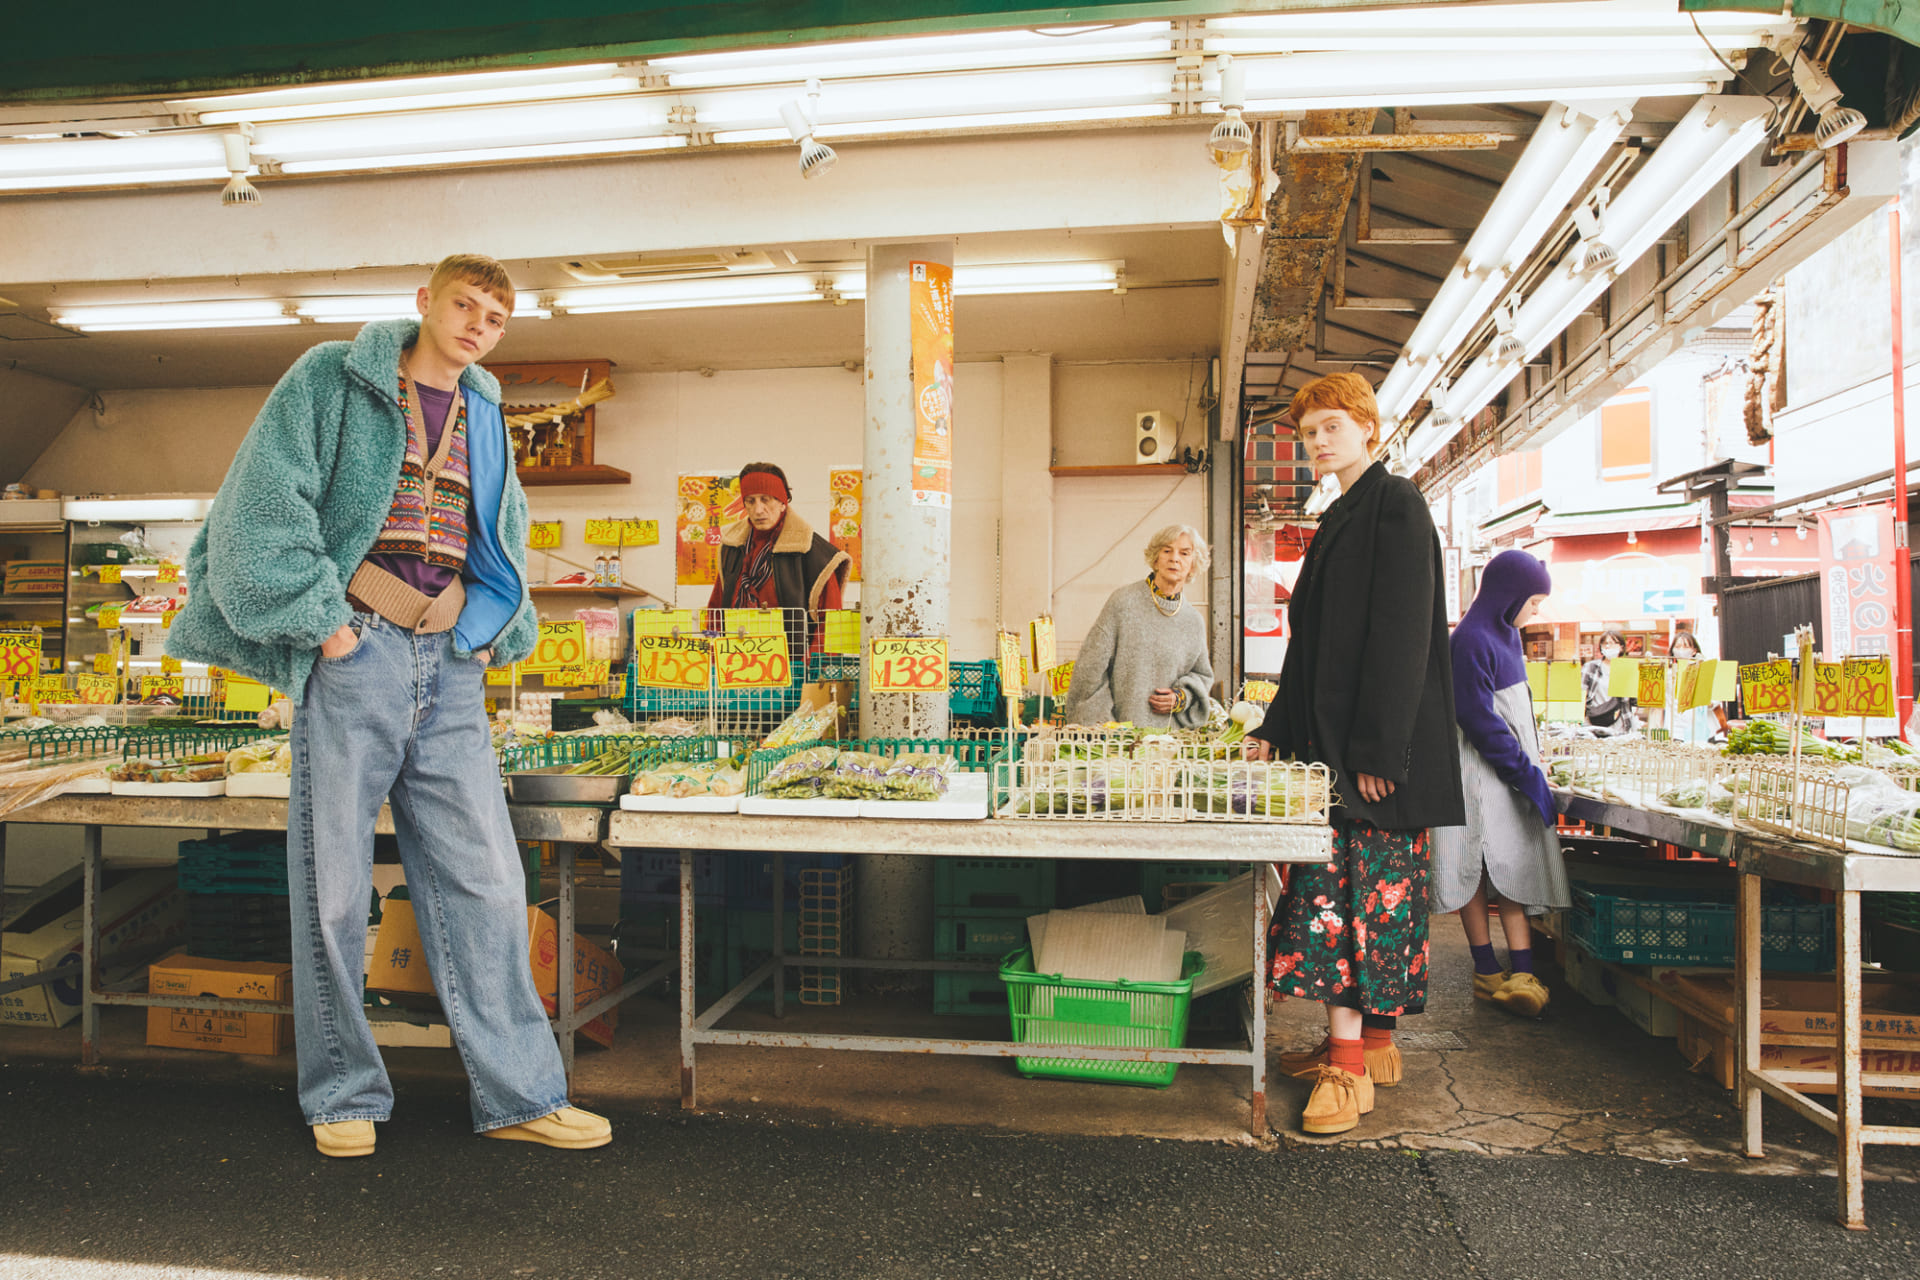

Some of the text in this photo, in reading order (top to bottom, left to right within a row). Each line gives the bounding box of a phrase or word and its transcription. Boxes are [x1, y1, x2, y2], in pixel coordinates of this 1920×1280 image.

[390, 948, 412, 969] 特
[178, 1016, 188, 1029] A
[203, 1018, 213, 1032] 4
